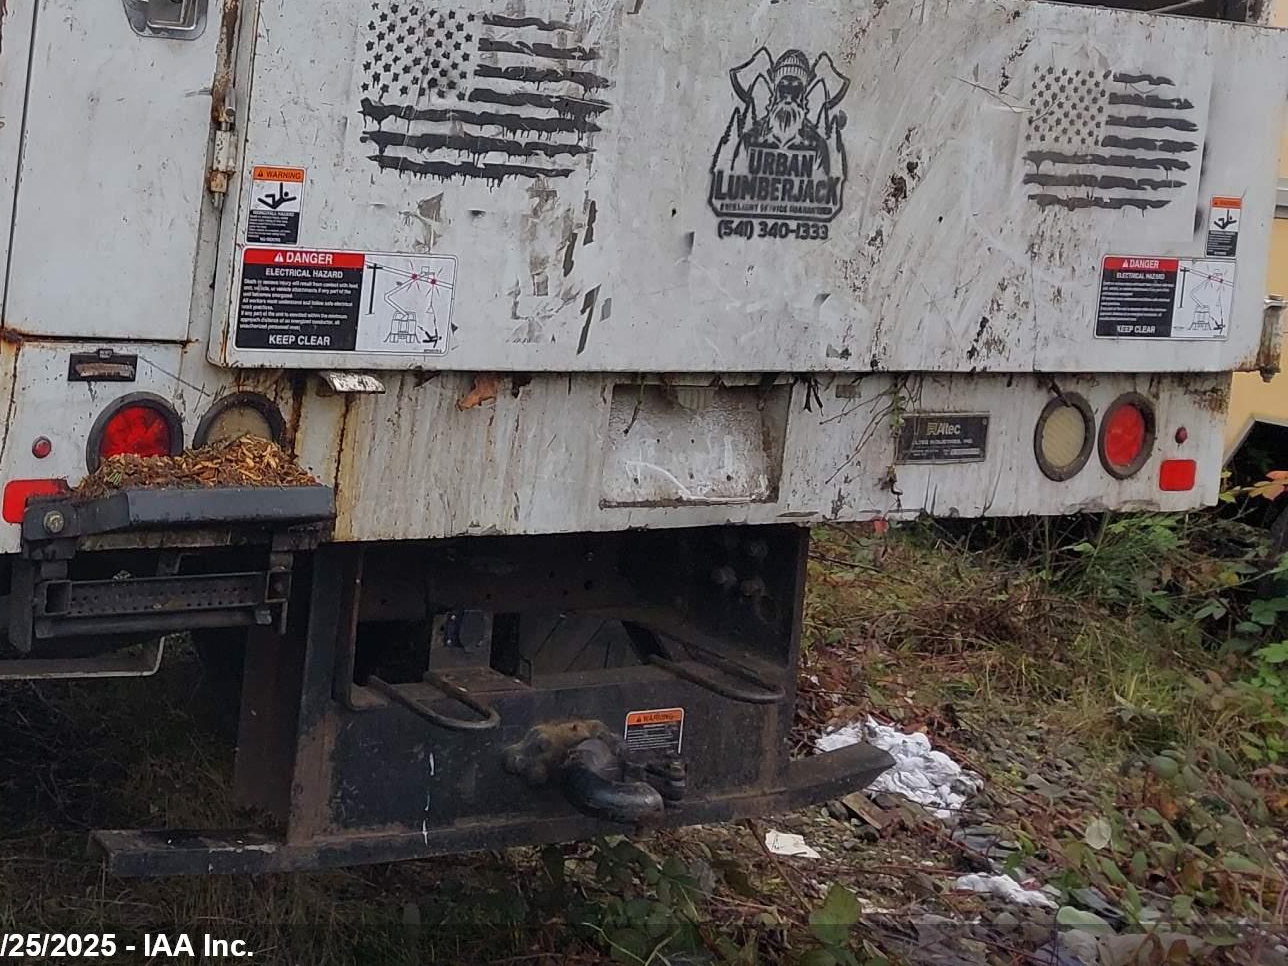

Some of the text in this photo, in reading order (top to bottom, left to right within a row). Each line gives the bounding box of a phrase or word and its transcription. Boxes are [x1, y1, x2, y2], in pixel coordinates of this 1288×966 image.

[749, 149, 814, 178] URBAN
[266, 170, 301, 179] WARNING
[715, 170, 840, 205] LUMBERJACK
[758, 221, 829, 240] 340-1333
[286, 252, 333, 264] DANGER
[1129, 260, 1160, 268] DANGER
[265, 268, 343, 278] ELECTRICAL HAZARD
[1117, 325, 1156, 333] KEEP CLEAR
[269, 335, 330, 346] KEEP CLEAR
[937, 423, 961, 435] Altec
